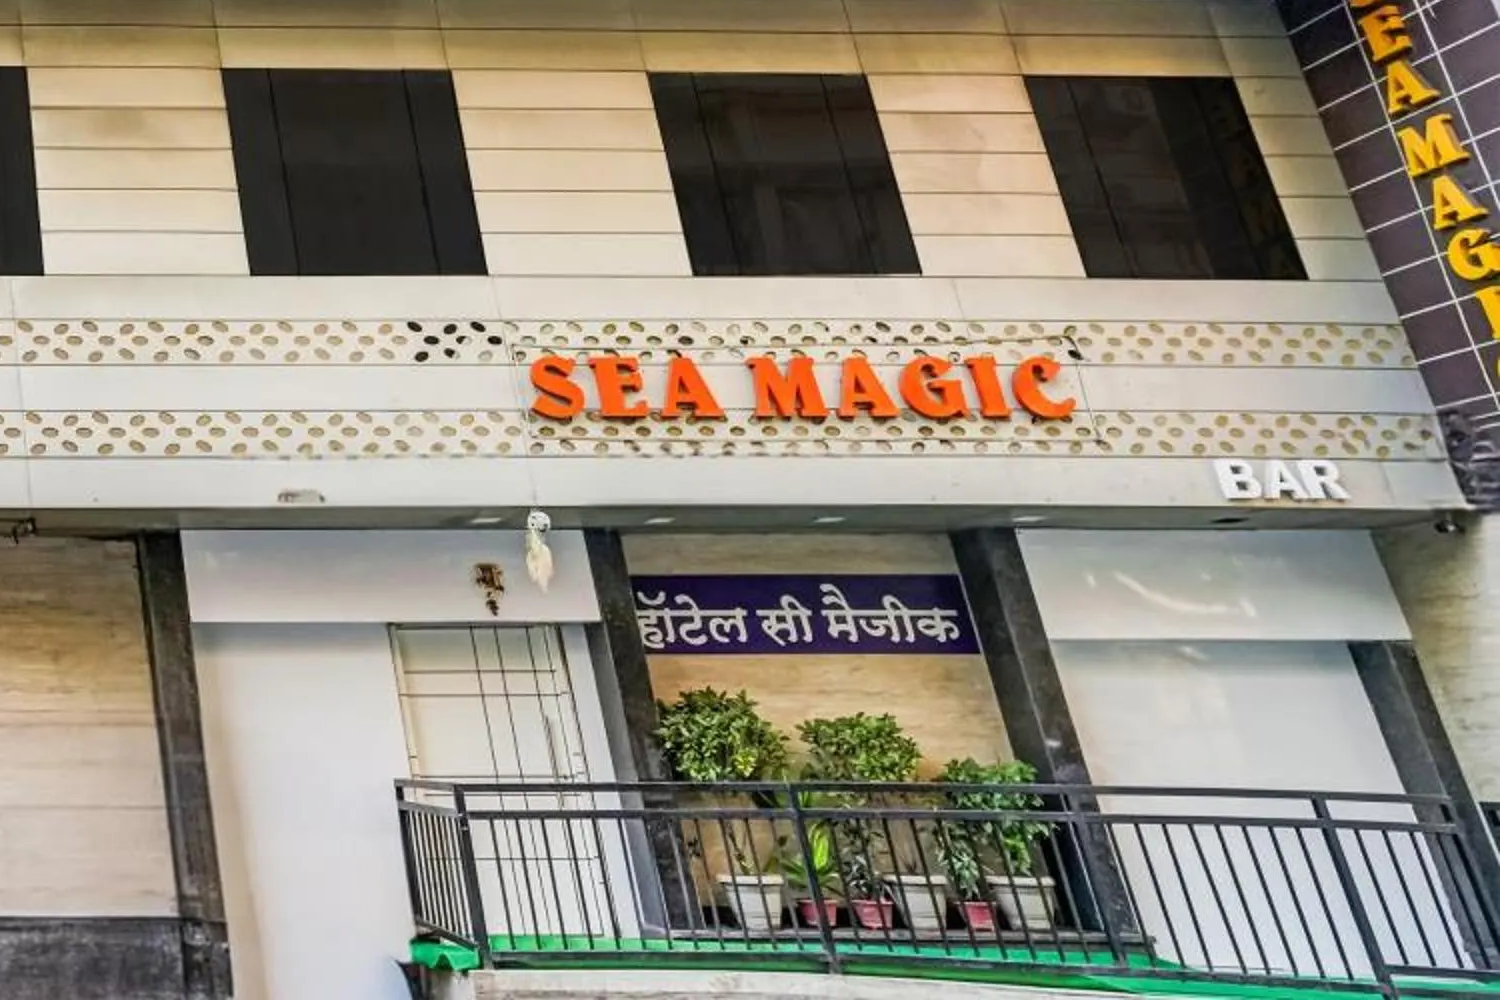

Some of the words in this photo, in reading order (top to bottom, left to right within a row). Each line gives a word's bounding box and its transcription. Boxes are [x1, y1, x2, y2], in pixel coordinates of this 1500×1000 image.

[530, 355, 726, 420] SEA
[746, 355, 1077, 420] MAGIC
[1213, 458, 1351, 502] BAR
[634, 591, 748, 649] हॉटेल
[756, 595, 813, 646] सी
[819, 583, 960, 644] मैजीक
